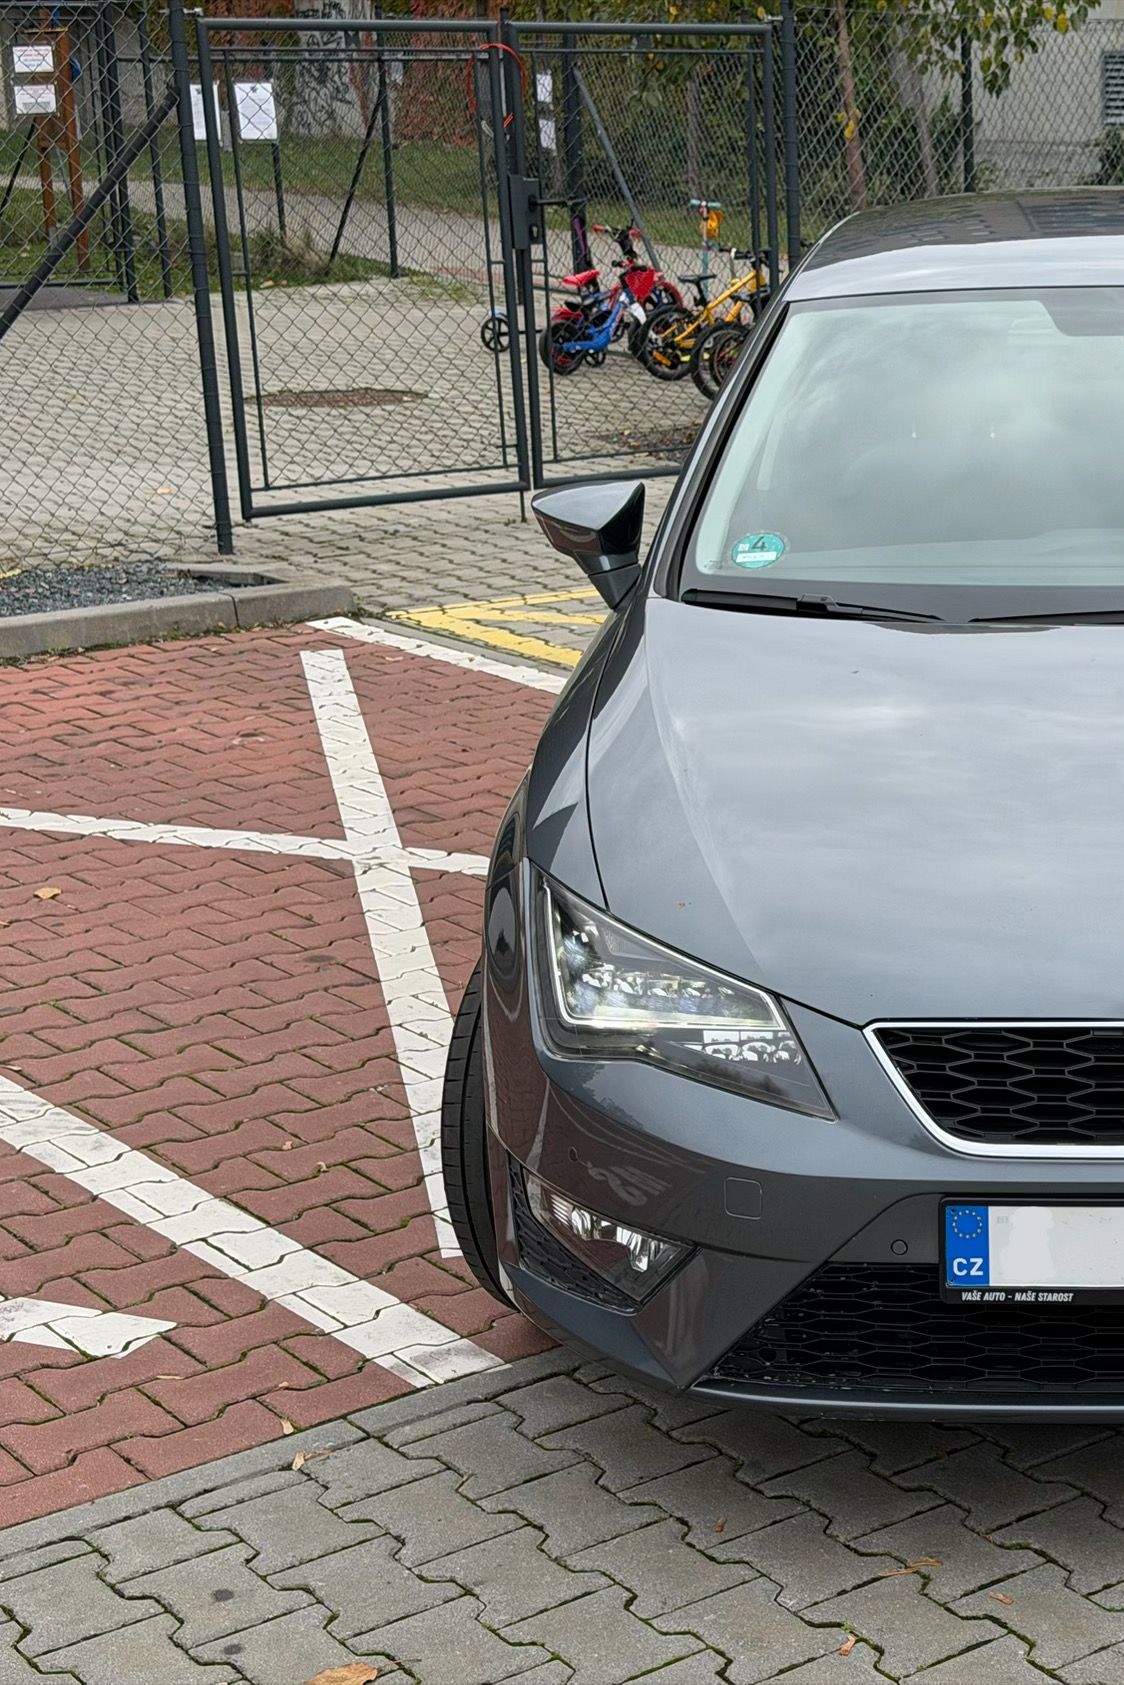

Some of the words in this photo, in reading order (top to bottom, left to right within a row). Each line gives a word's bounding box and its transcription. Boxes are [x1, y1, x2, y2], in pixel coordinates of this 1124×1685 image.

[751, 536, 767, 551] 4
[952, 1257, 984, 1276] CZ
[961, 1290, 981, 1301] VAŠE
[983, 1292, 1005, 1301] AUTO
[1014, 1290, 1036, 1302] NAŠE
[1038, 1292, 1074, 1302] STAROST
